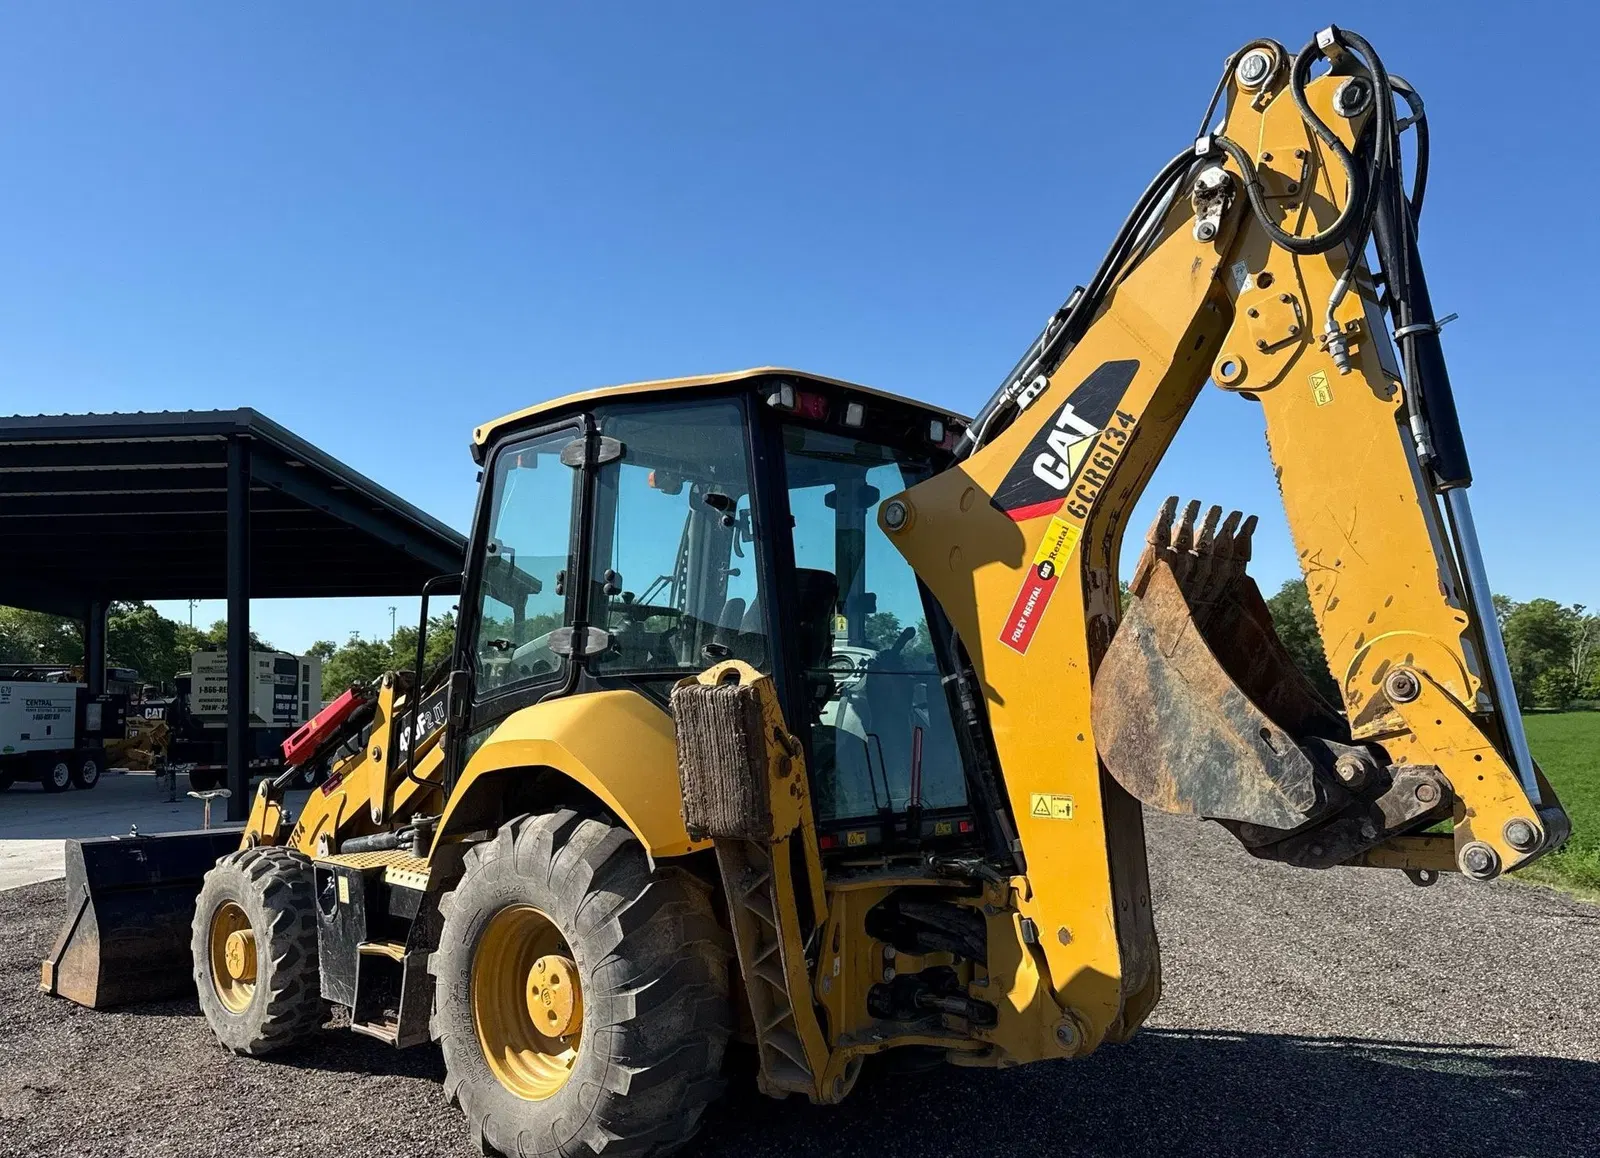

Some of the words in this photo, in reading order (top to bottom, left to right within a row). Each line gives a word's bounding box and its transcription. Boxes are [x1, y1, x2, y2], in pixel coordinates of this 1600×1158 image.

[1032, 402, 1099, 491] CAT
[1066, 409, 1137, 520] 6CR6134
[1048, 525, 1069, 561] Rental
[1040, 562, 1053, 579] CAT
[1011, 616, 1027, 643] FOLEY
[1022, 586, 1043, 618] RENTAL
[26, 699, 53, 707] CENTRAL
[199, 686, 227, 694] 1-866-RE
[145, 707, 165, 720] CAT
